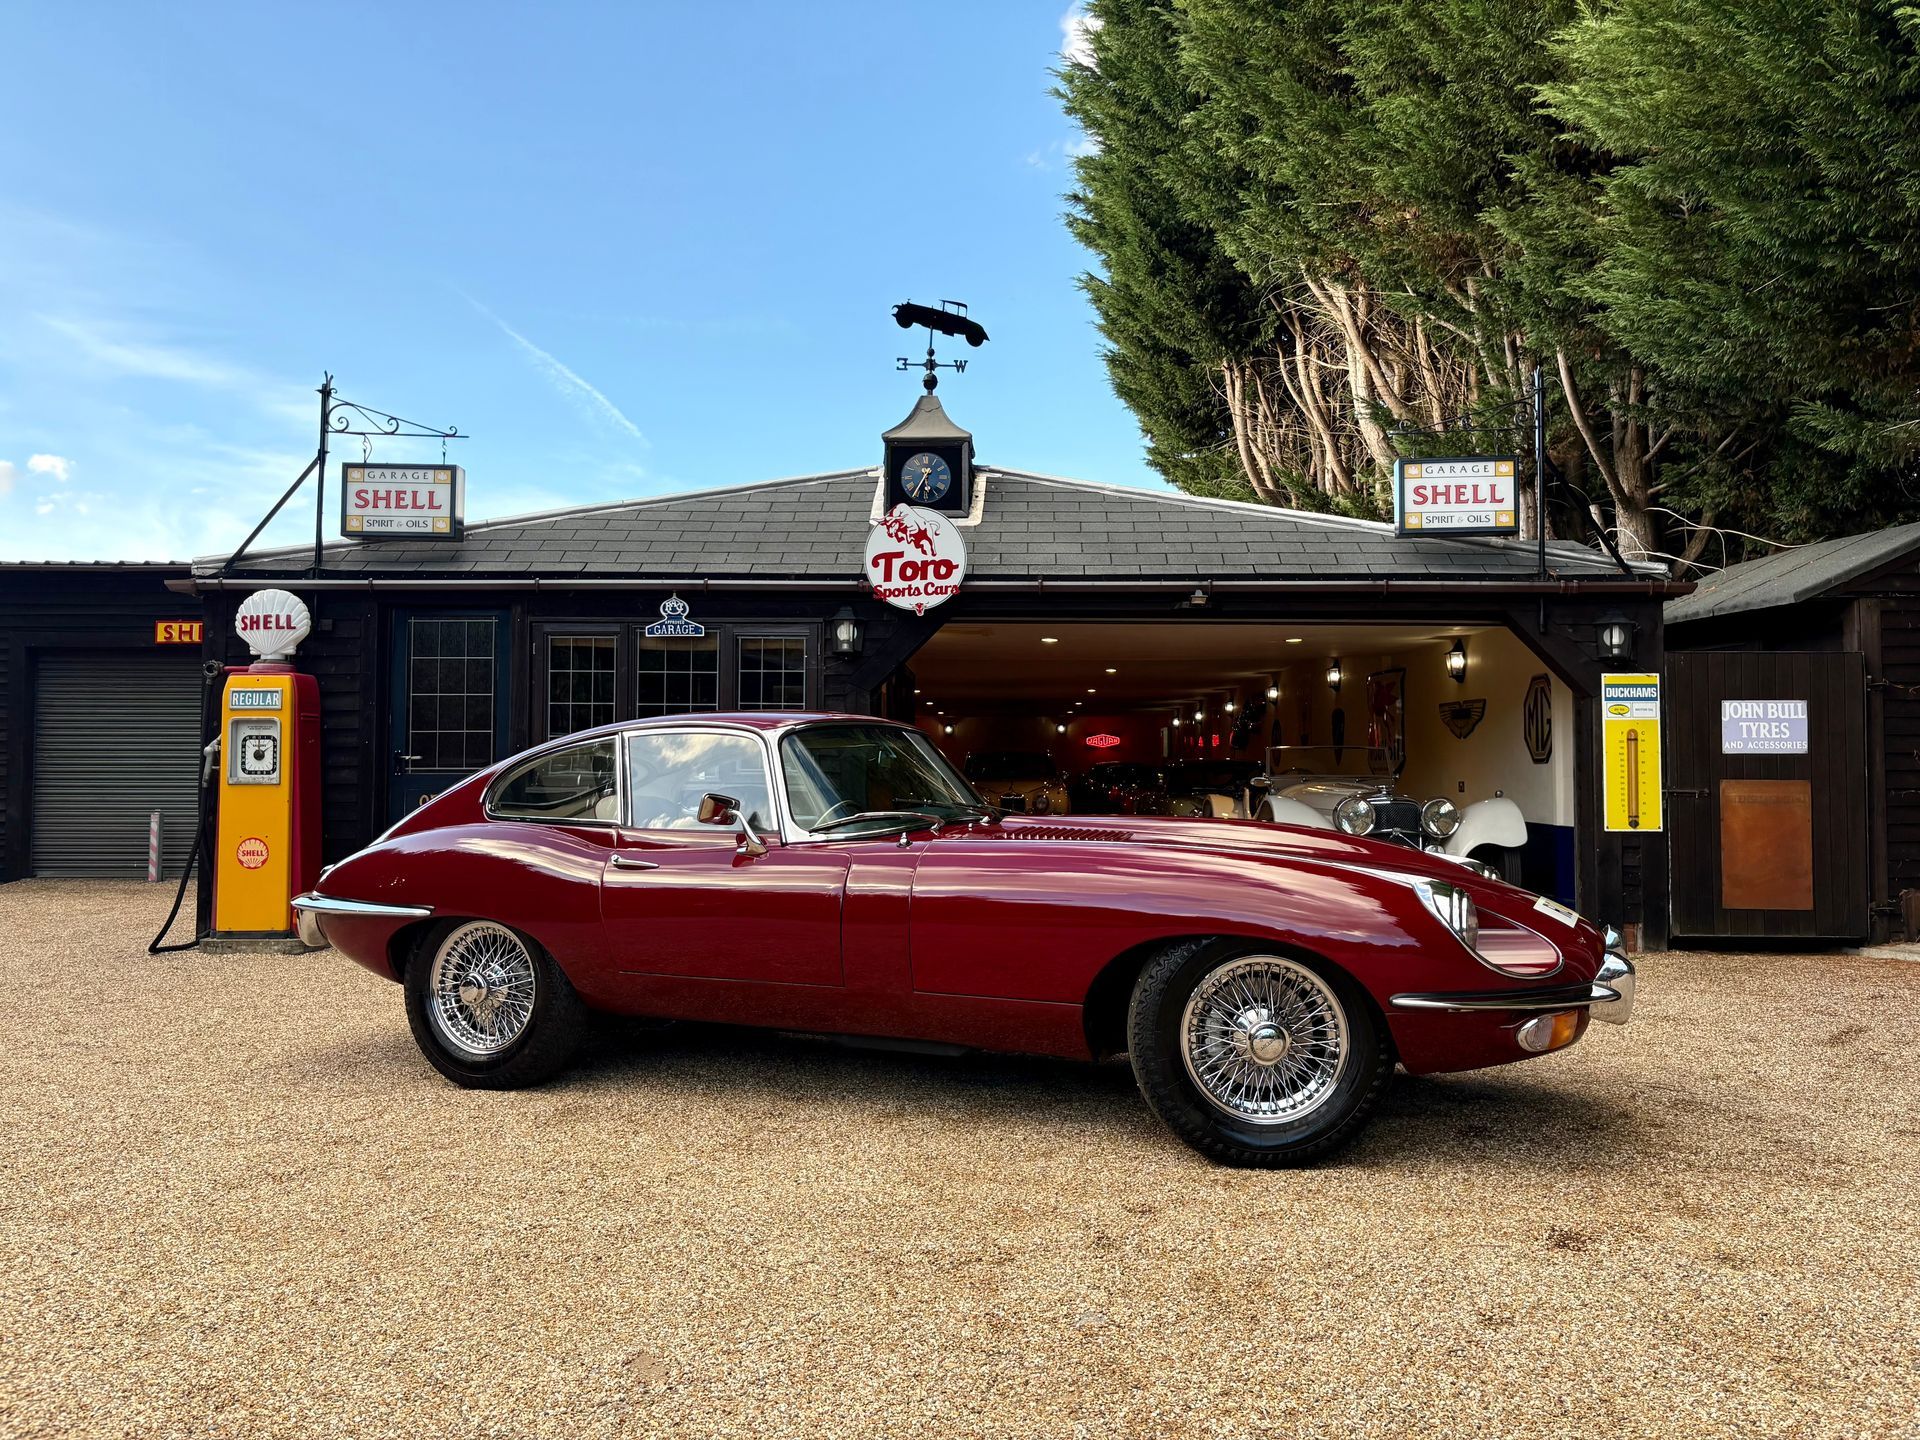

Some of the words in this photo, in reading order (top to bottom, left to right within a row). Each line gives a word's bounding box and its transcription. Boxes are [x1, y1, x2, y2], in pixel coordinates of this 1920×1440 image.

[954, 360, 968, 373] W
[367, 471, 429, 480] GARAGE
[1425, 465, 1489, 474] GARAGE
[354, 489, 442, 510] SHELL
[1412, 484, 1504, 505] SHELL
[366, 519, 394, 528] SPIRIT
[405, 519, 429, 529] OILS
[1425, 515, 1455, 524] SPIRIT
[1467, 514, 1491, 523] OILS
[872, 551, 959, 582] Toro
[873, 584, 922, 602] Sports
[924, 582, 960, 596] Cars
[241, 614, 297, 631] SHELL
[654, 625, 696, 635] GARAGE
[232, 692, 279, 706] REGULAR
[1606, 687, 1657, 698] DUCKHAMS
[1722, 702, 1764, 721] JOHN
[1767, 702, 1807, 719] BULL
[1739, 722, 1790, 738] TYRES
[1724, 741, 1744, 749] AND
[1747, 740, 1808, 749] ACCESSORIES
[241, 849, 264, 857] SHELL
